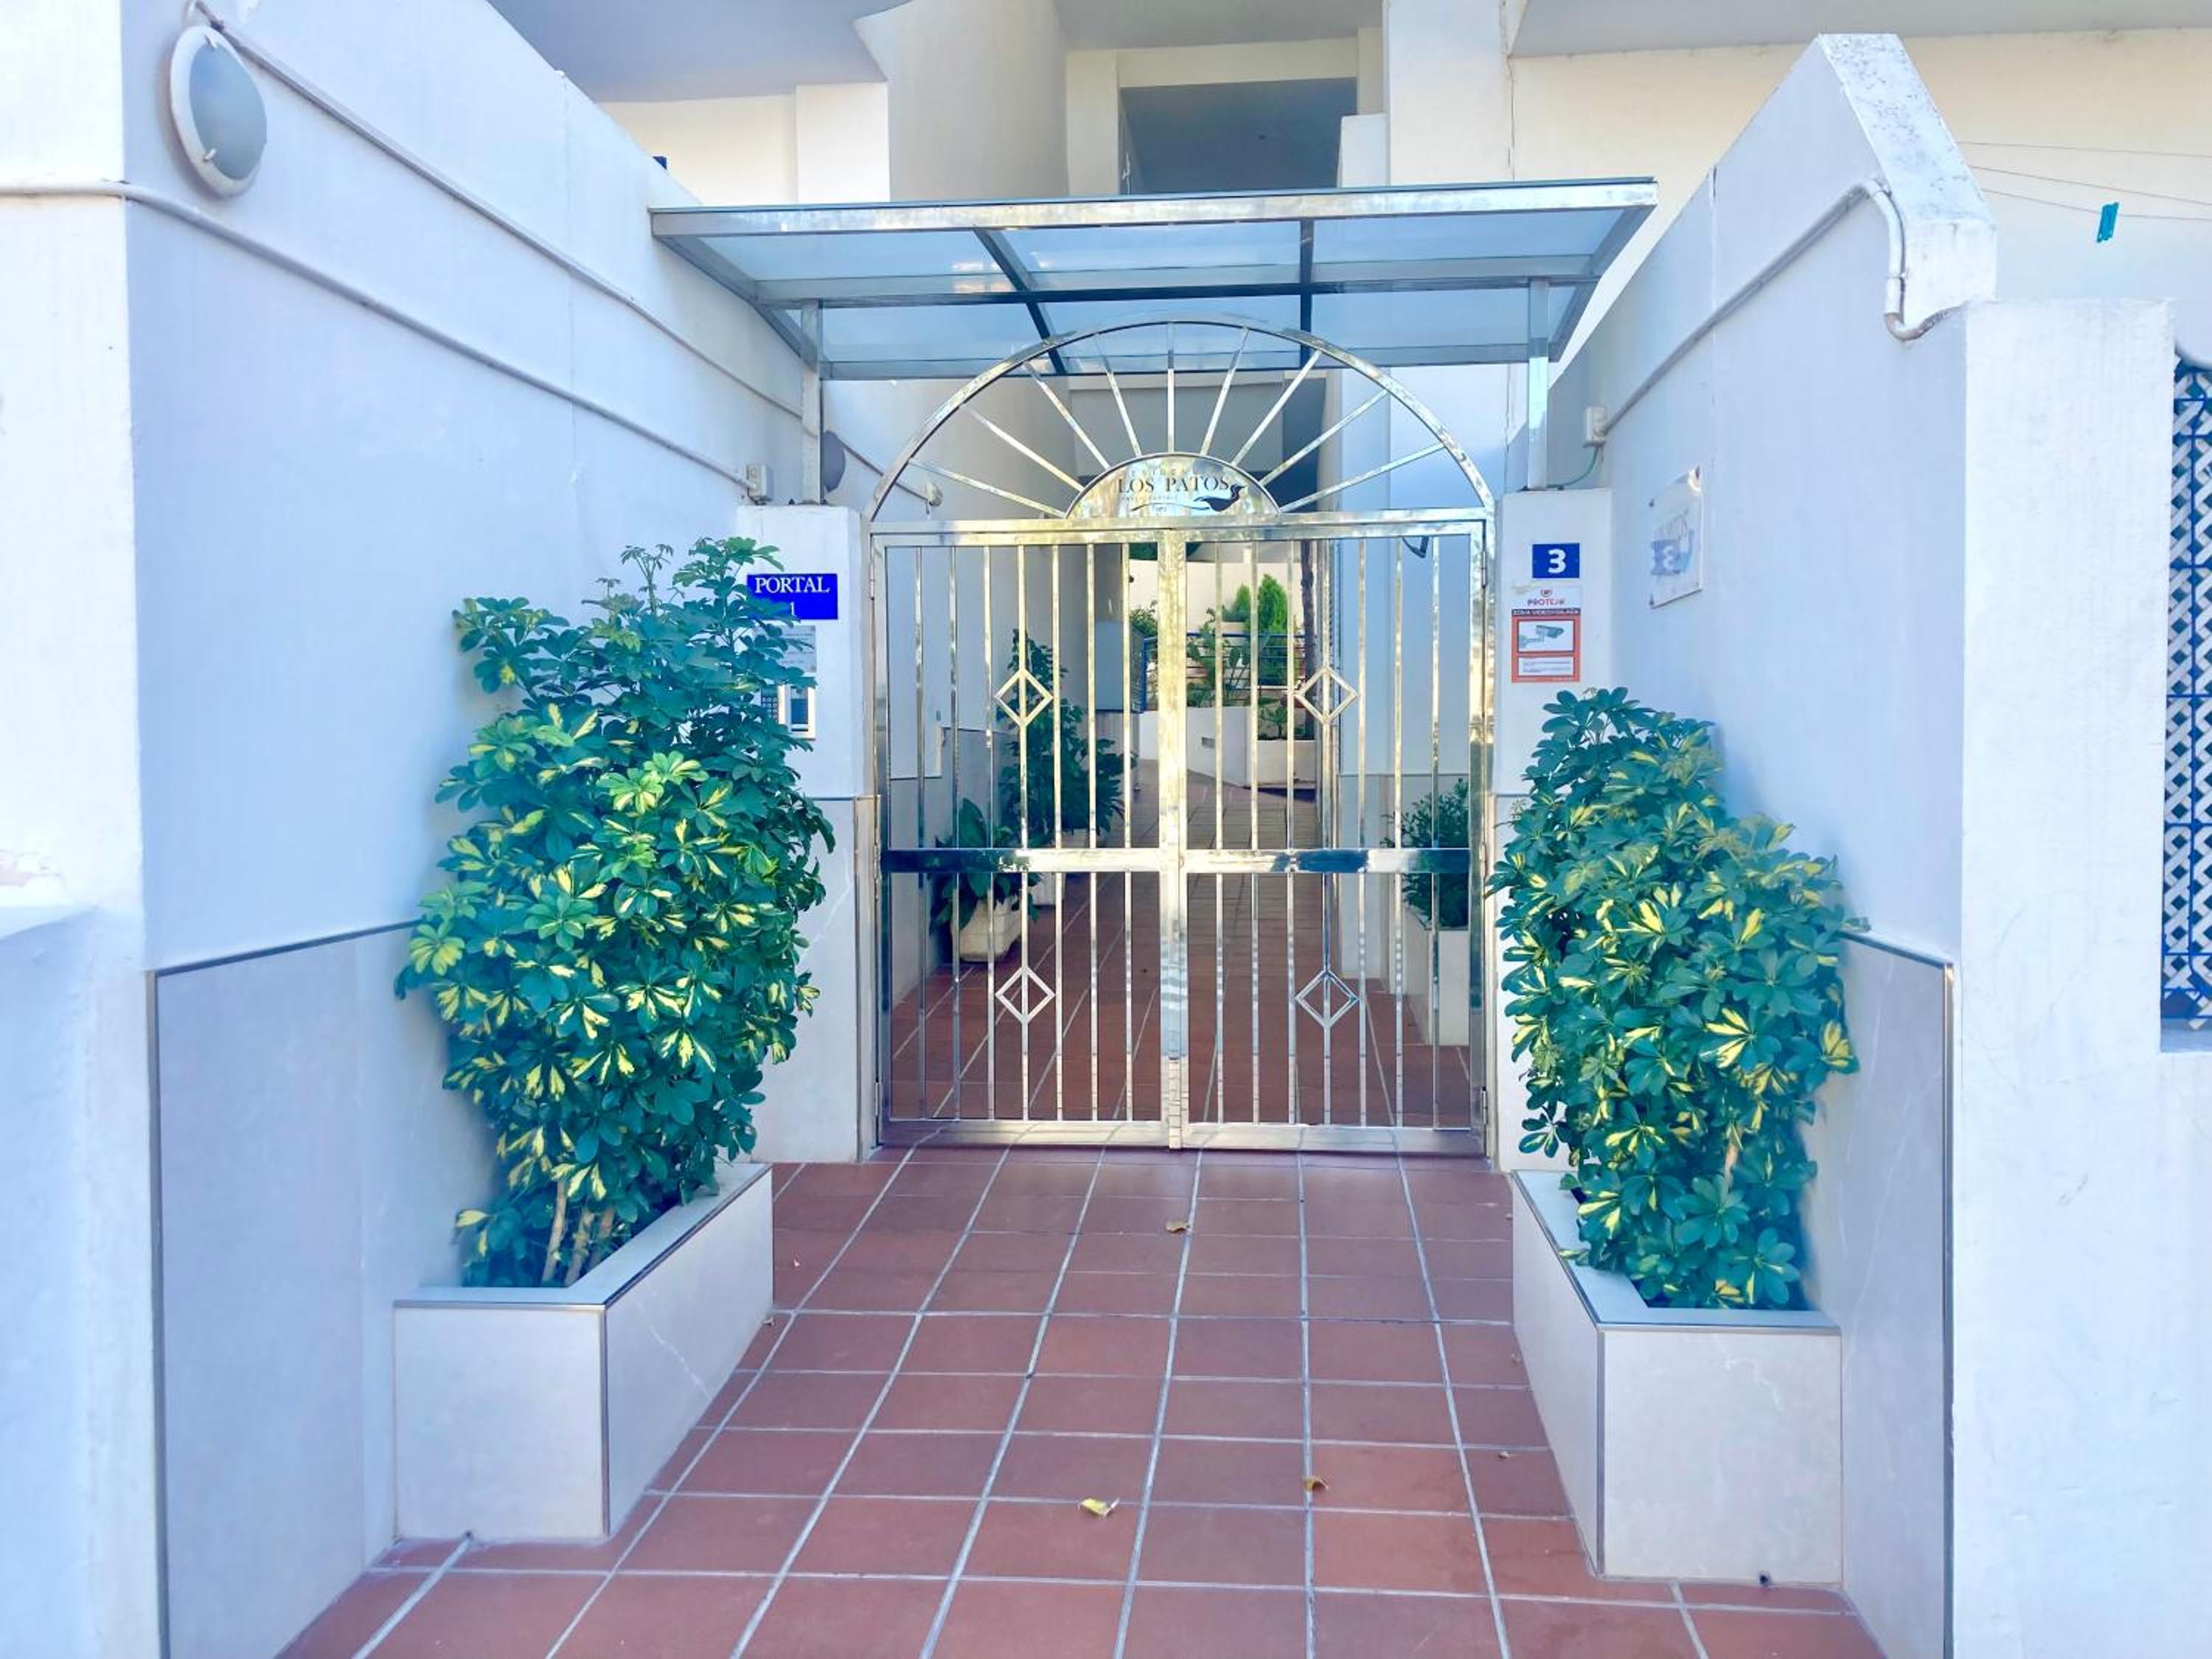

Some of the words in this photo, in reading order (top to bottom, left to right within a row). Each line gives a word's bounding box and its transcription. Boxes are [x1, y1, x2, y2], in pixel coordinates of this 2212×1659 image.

[1118, 478, 1154, 493] LOS
[1166, 476, 1229, 493] PATOS
[1548, 548, 1567, 574] 3
[754, 576, 830, 594] PORTAL
